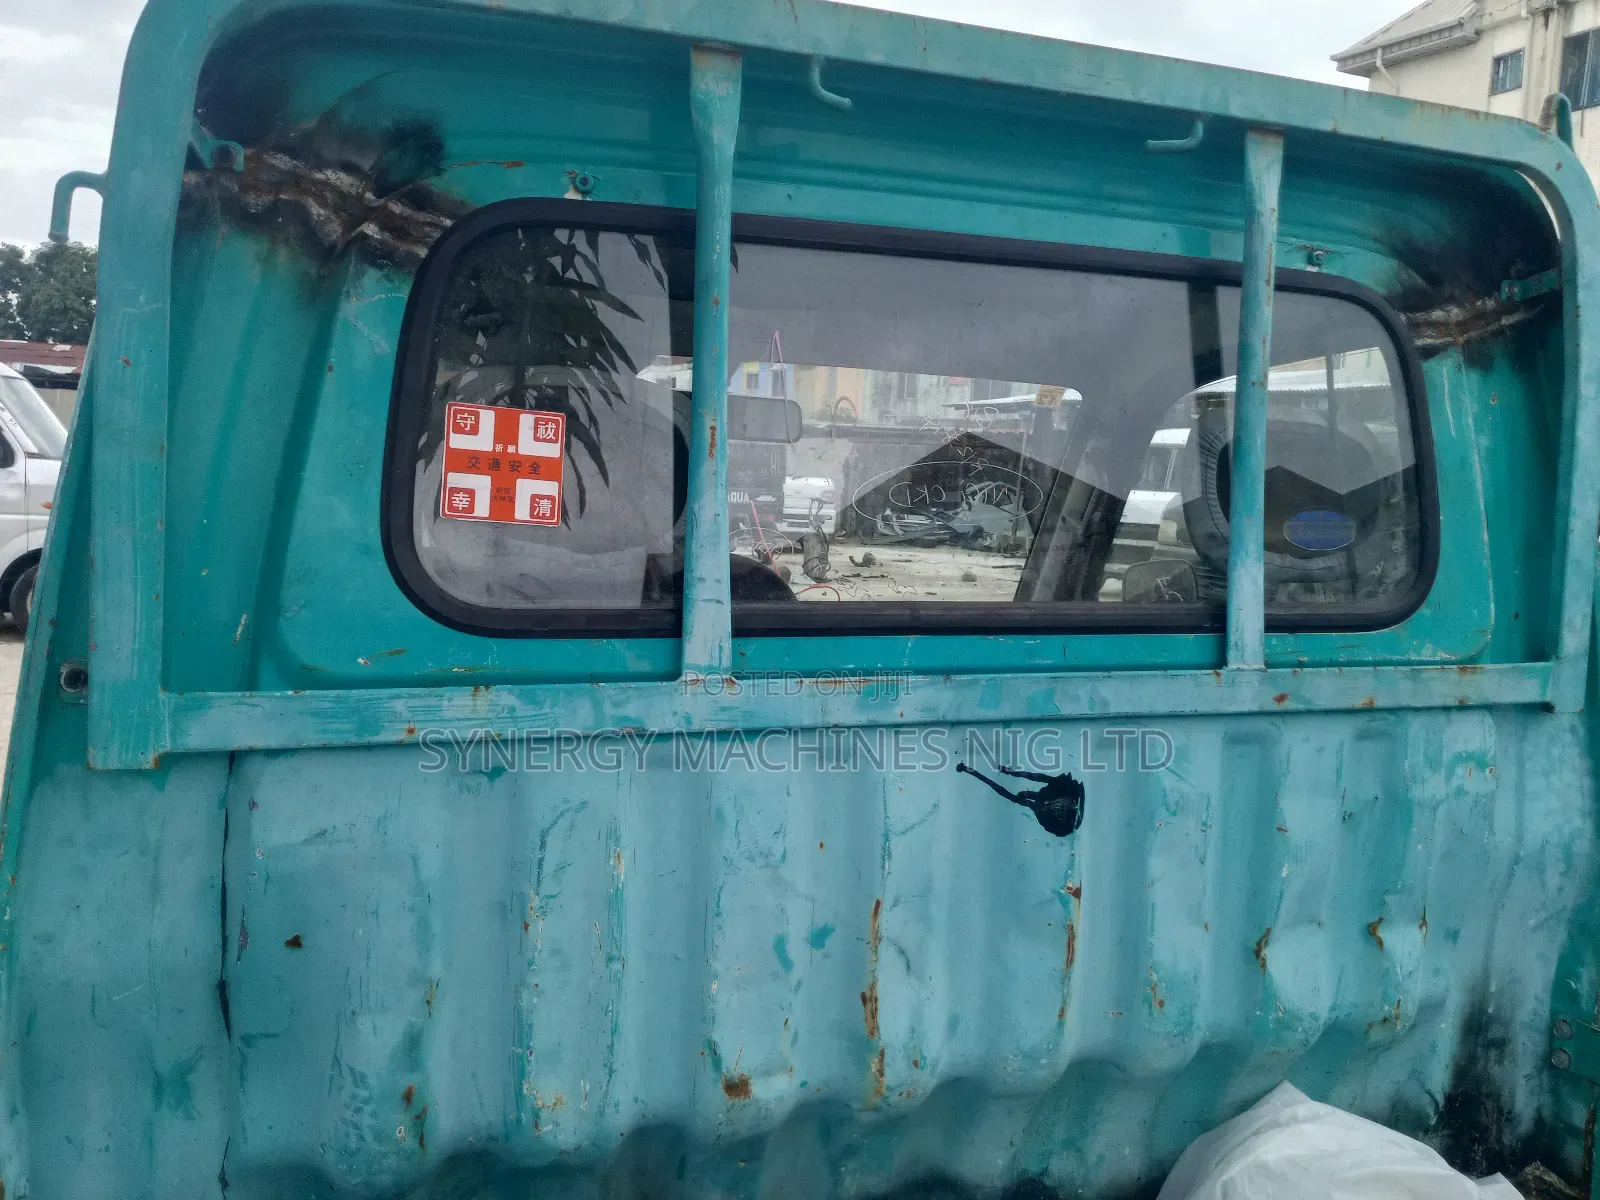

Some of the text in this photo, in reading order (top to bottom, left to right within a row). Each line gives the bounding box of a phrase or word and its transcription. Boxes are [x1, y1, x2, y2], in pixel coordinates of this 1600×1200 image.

[456, 413, 475, 431] 守
[537, 421, 557, 440] 祓
[495, 443, 517, 454] 祈願
[467, 456, 542, 475] 交通安全
[451, 492, 471, 511] 幸
[533, 499, 553, 517] 清
